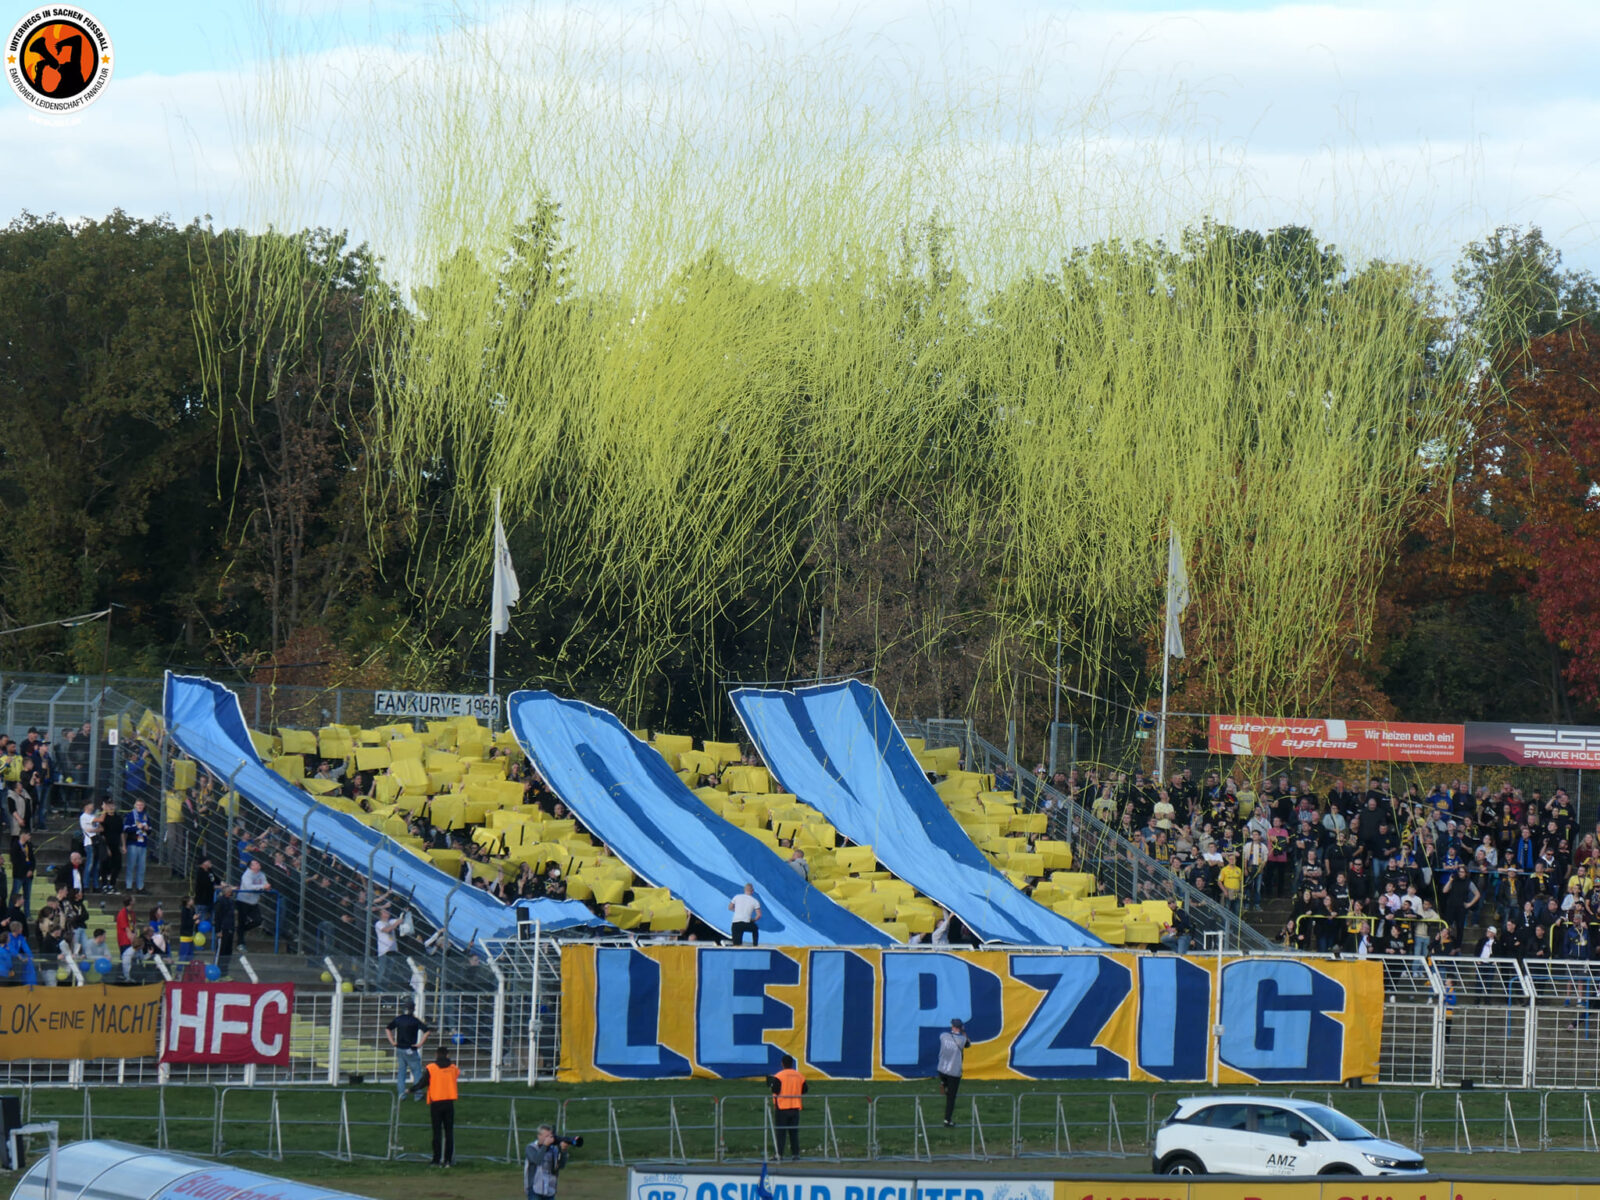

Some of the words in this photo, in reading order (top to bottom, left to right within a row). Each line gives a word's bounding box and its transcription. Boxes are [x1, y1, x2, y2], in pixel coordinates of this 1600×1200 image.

[376, 693, 461, 715] FANKURVE
[465, 698, 499, 716] 1966
[1219, 722, 1324, 737] waterproof
[1364, 729, 1380, 740] Wir
[1382, 730, 1411, 741] heizen
[1413, 732, 1435, 742] euch
[1437, 732, 1454, 743] ein!
[1281, 738, 1358, 750] systems
[1523, 750, 1569, 760] SPAUKE
[91, 1001, 158, 1034] MACHT
[169, 988, 288, 1057] HFC
[593, 946, 1347, 1084] LEIPZIG
[1267, 1154, 1297, 1167] AMZ
